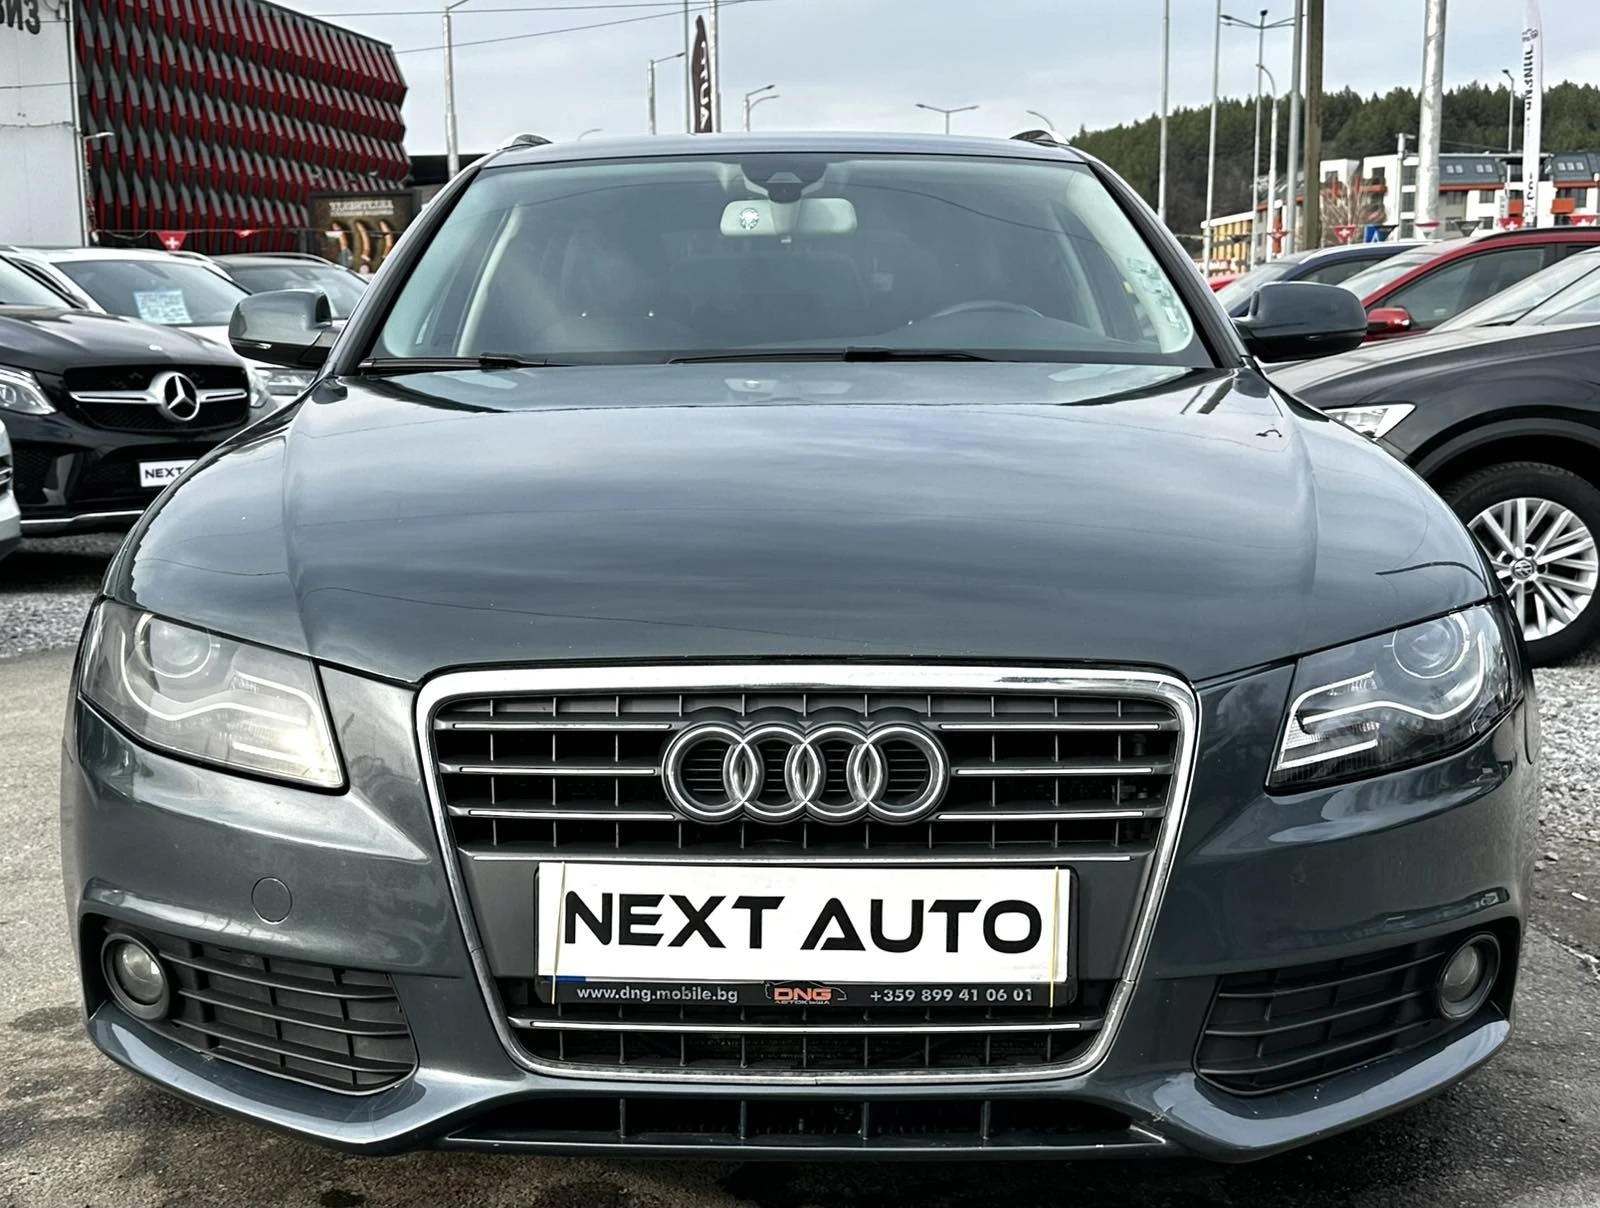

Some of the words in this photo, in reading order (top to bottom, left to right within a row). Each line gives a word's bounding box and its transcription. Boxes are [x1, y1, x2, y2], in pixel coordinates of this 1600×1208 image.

[145, 467, 184, 478] NEXT
[564, 890, 785, 950] NEXT
[800, 896, 1043, 955] AUTO
[576, 985, 738, 1003] www.dng.mobile.bg
[774, 987, 832, 1001] DNG
[870, 988, 916, 1002] +359
[921, 988, 953, 1002] 899
[958, 988, 978, 1002] 41
[985, 988, 1007, 1002] 06
[1013, 988, 1032, 1002] 01
